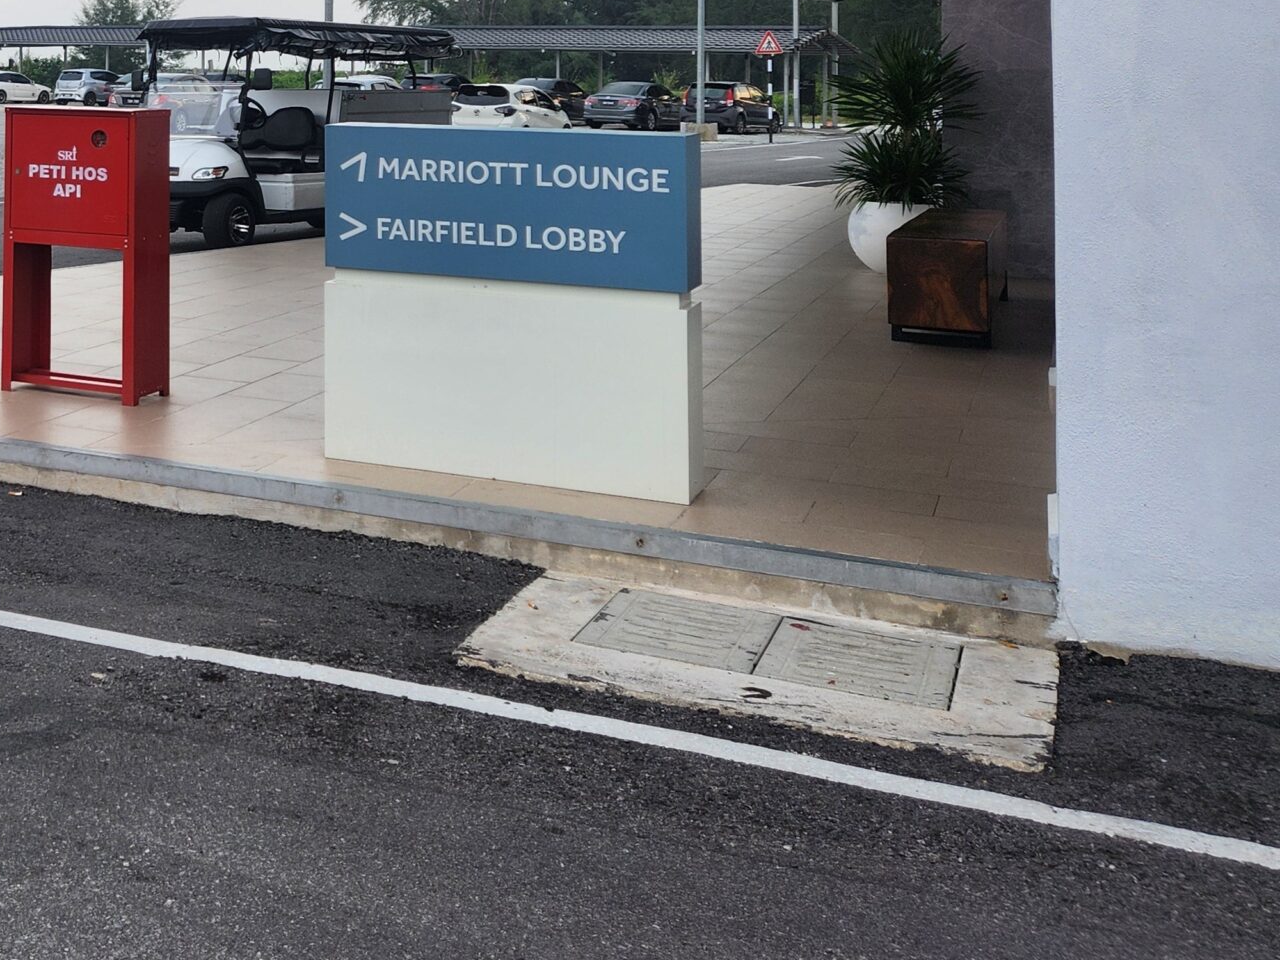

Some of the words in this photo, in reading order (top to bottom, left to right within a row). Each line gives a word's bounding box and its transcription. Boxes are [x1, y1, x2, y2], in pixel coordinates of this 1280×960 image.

[28, 164, 66, 179] PETI
[72, 167, 108, 181] HOS
[378, 157, 529, 186] MARRIOTT
[536, 164, 670, 194] LOUNGE
[52, 183, 81, 198] API
[376, 217, 518, 248] FAIRFIELD
[526, 225, 626, 255] LOBBY
